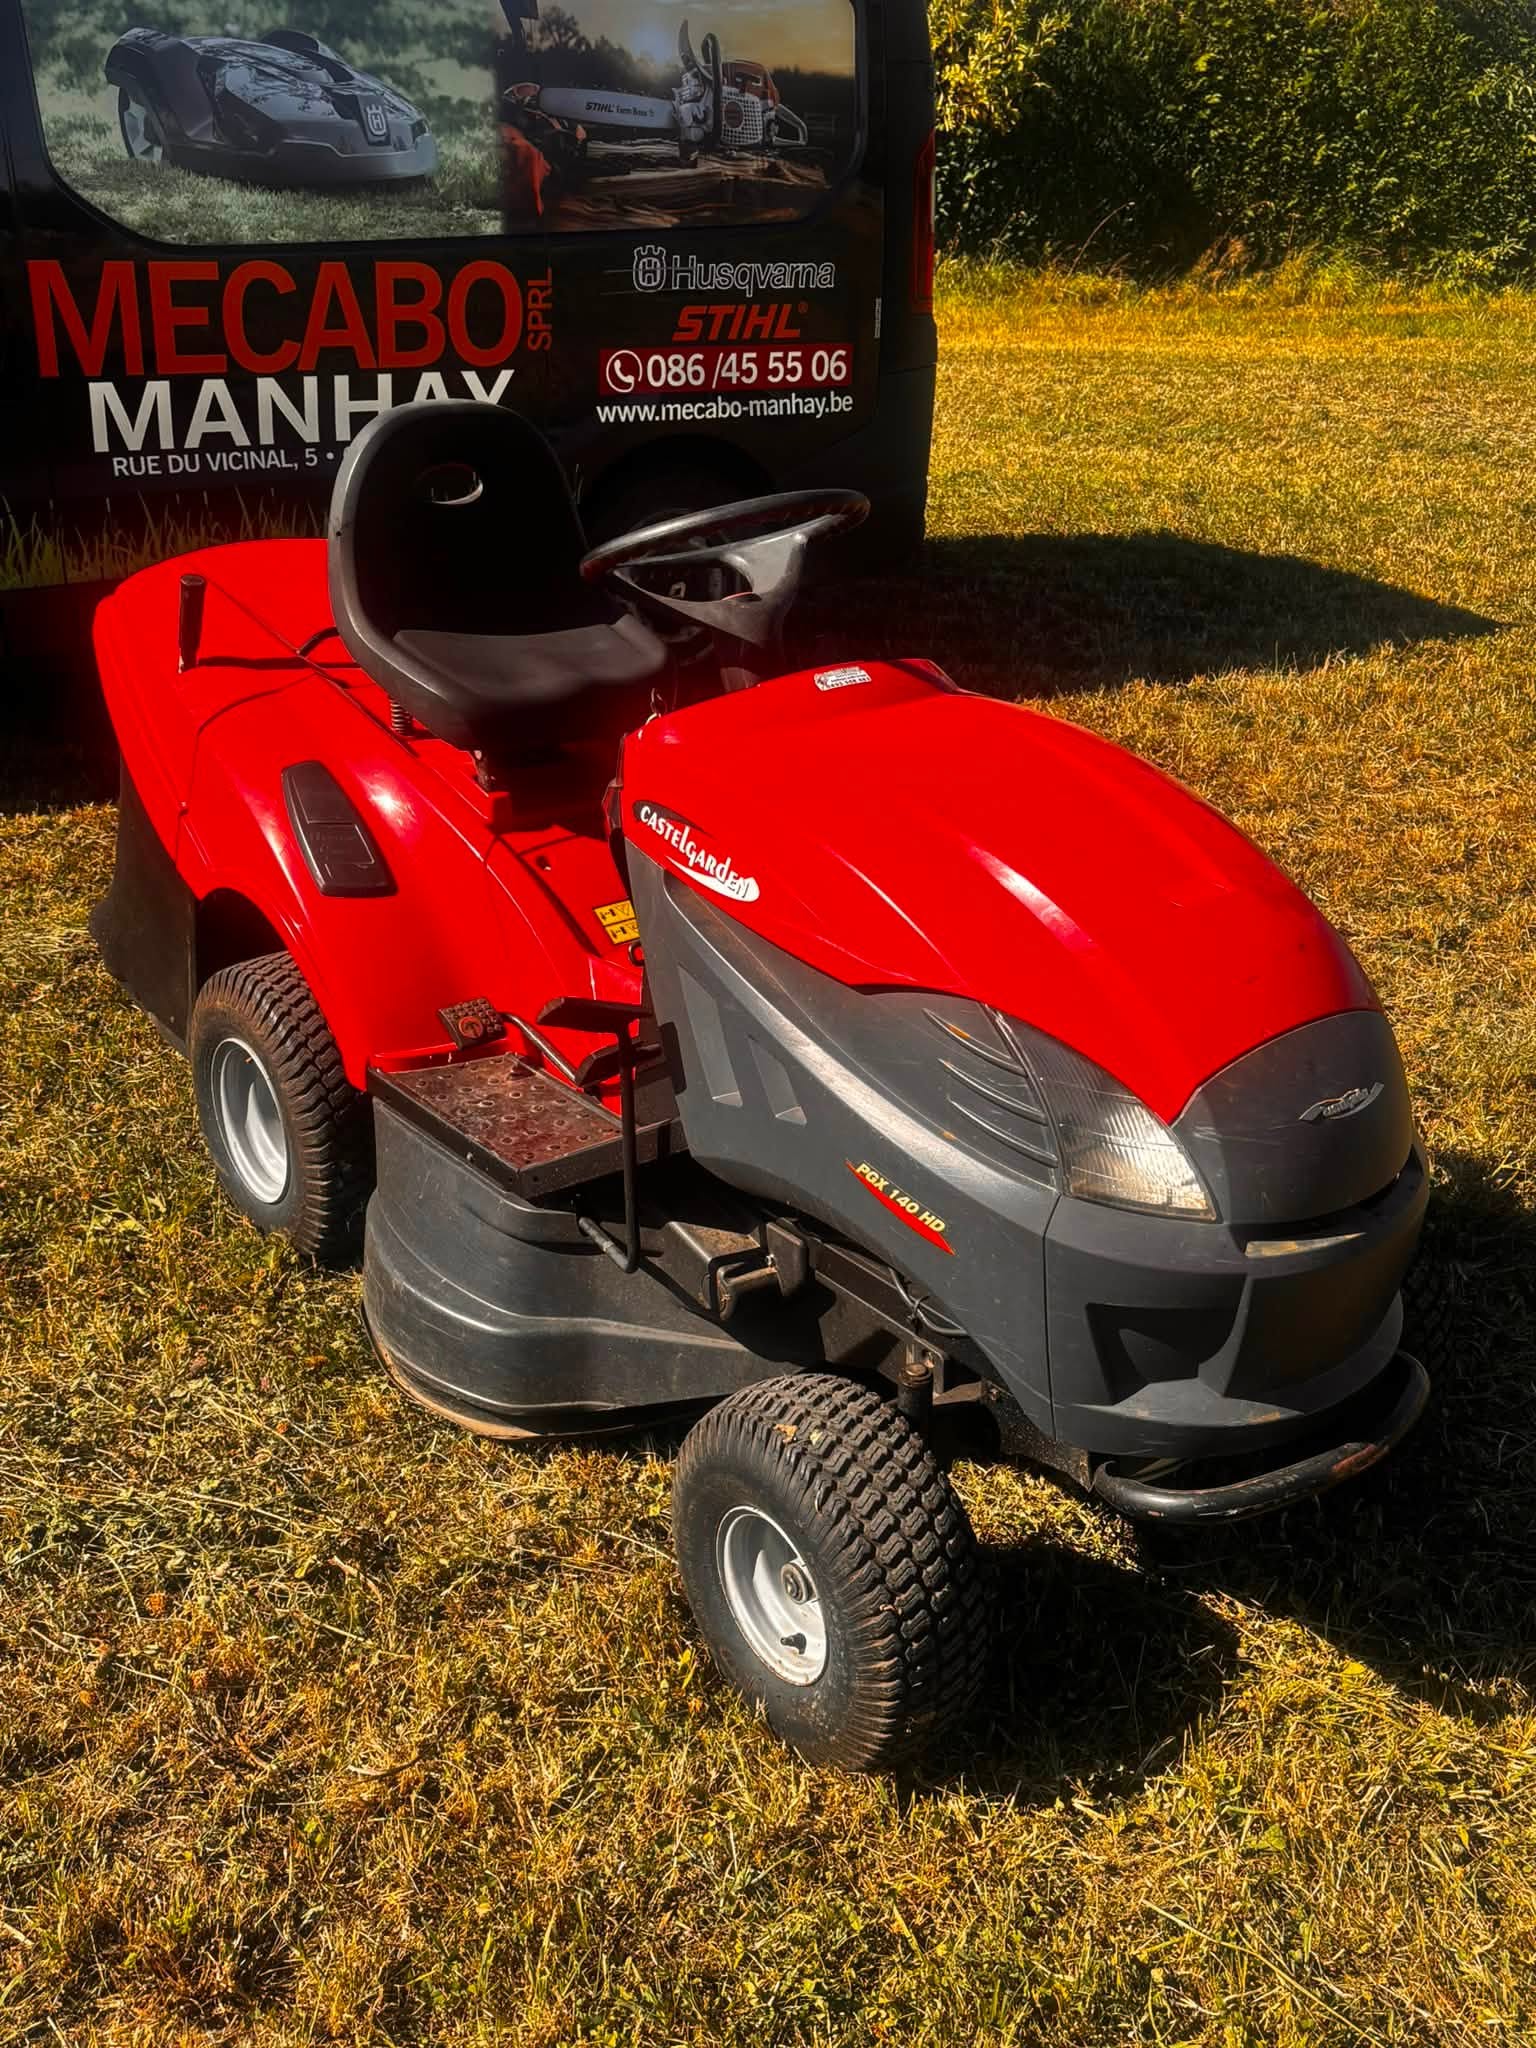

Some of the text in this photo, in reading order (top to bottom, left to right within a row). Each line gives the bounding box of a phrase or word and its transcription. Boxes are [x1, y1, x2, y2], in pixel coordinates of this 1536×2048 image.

[671, 255, 836, 297] Husqvarna
[26, 260, 524, 378] MECABO
[527, 266, 554, 351] SPRL
[647, 353, 706, 387] 086
[767, 351, 802, 383] 55
[811, 350, 847, 381] 06
[596, 391, 853, 424] www.mecabo-manhay.be
[113, 447, 318, 477] RUE DU VICINAL, 5
[855, 1162, 946, 1233] PGX 140 HD
